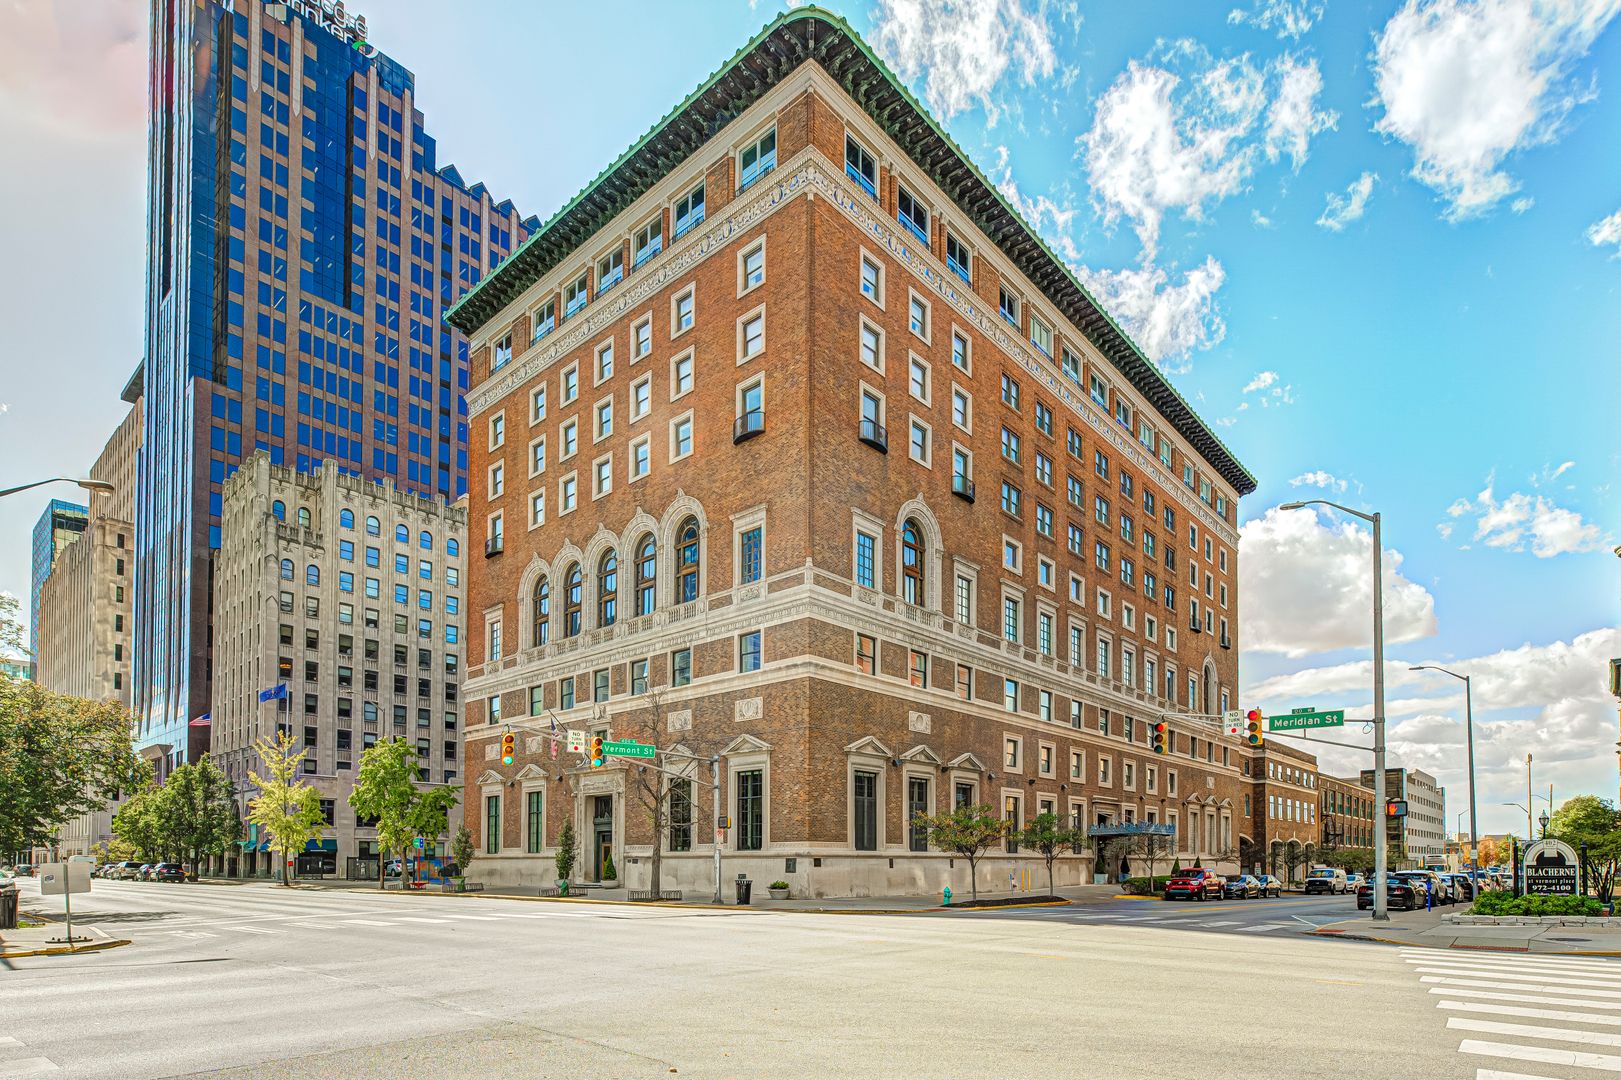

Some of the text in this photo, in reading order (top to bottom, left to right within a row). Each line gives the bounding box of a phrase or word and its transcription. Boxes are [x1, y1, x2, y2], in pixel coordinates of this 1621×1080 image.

[1274, 715, 1338, 728] Meridian St
[604, 745, 640, 754] Vermont
[1527, 868, 1576, 876] BLACHERNE
